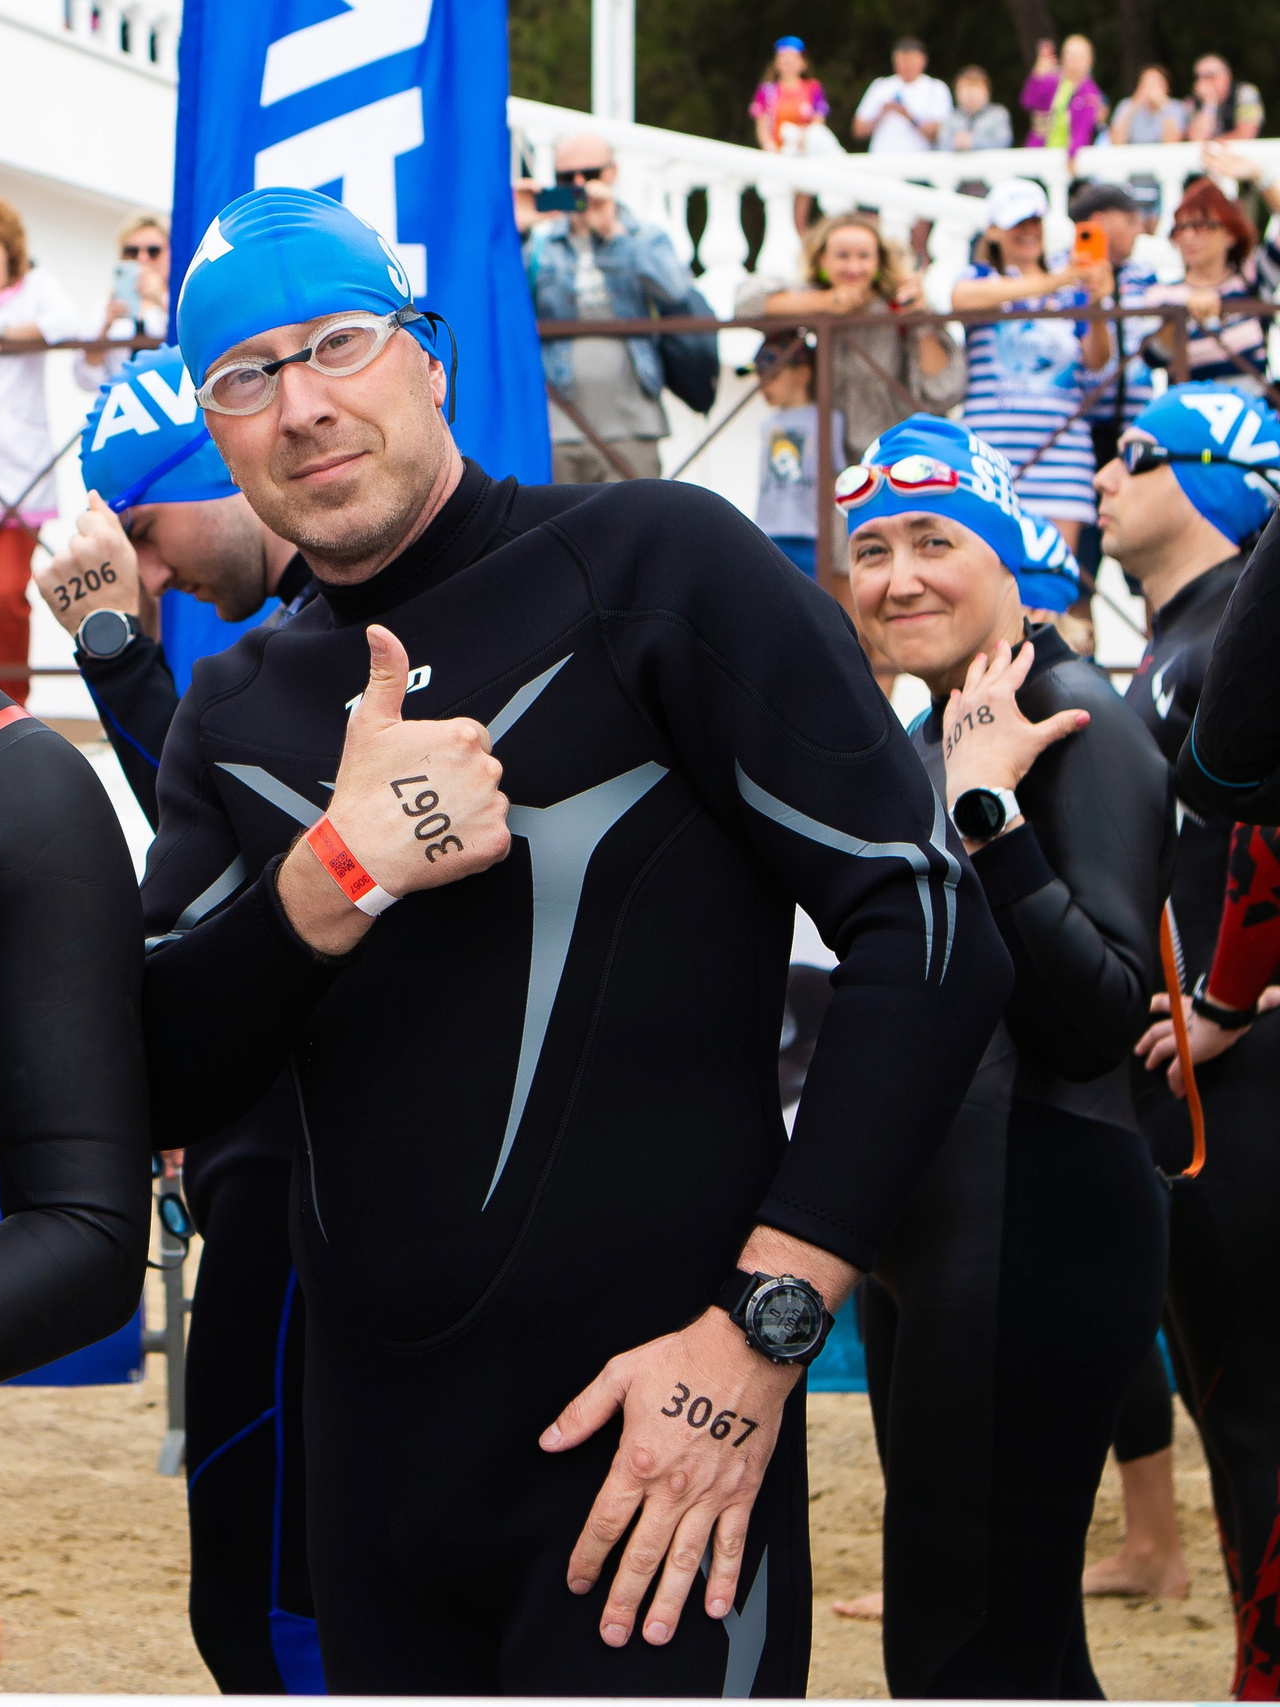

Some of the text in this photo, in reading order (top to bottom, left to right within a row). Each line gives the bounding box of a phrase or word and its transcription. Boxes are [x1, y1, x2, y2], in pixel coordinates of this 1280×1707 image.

[54, 561, 117, 612] 3206
[946, 705, 995, 760] 3018
[390, 774, 464, 864] 3067
[350, 875, 371, 895] 3067
[661, 1381, 759, 1448] 3067
